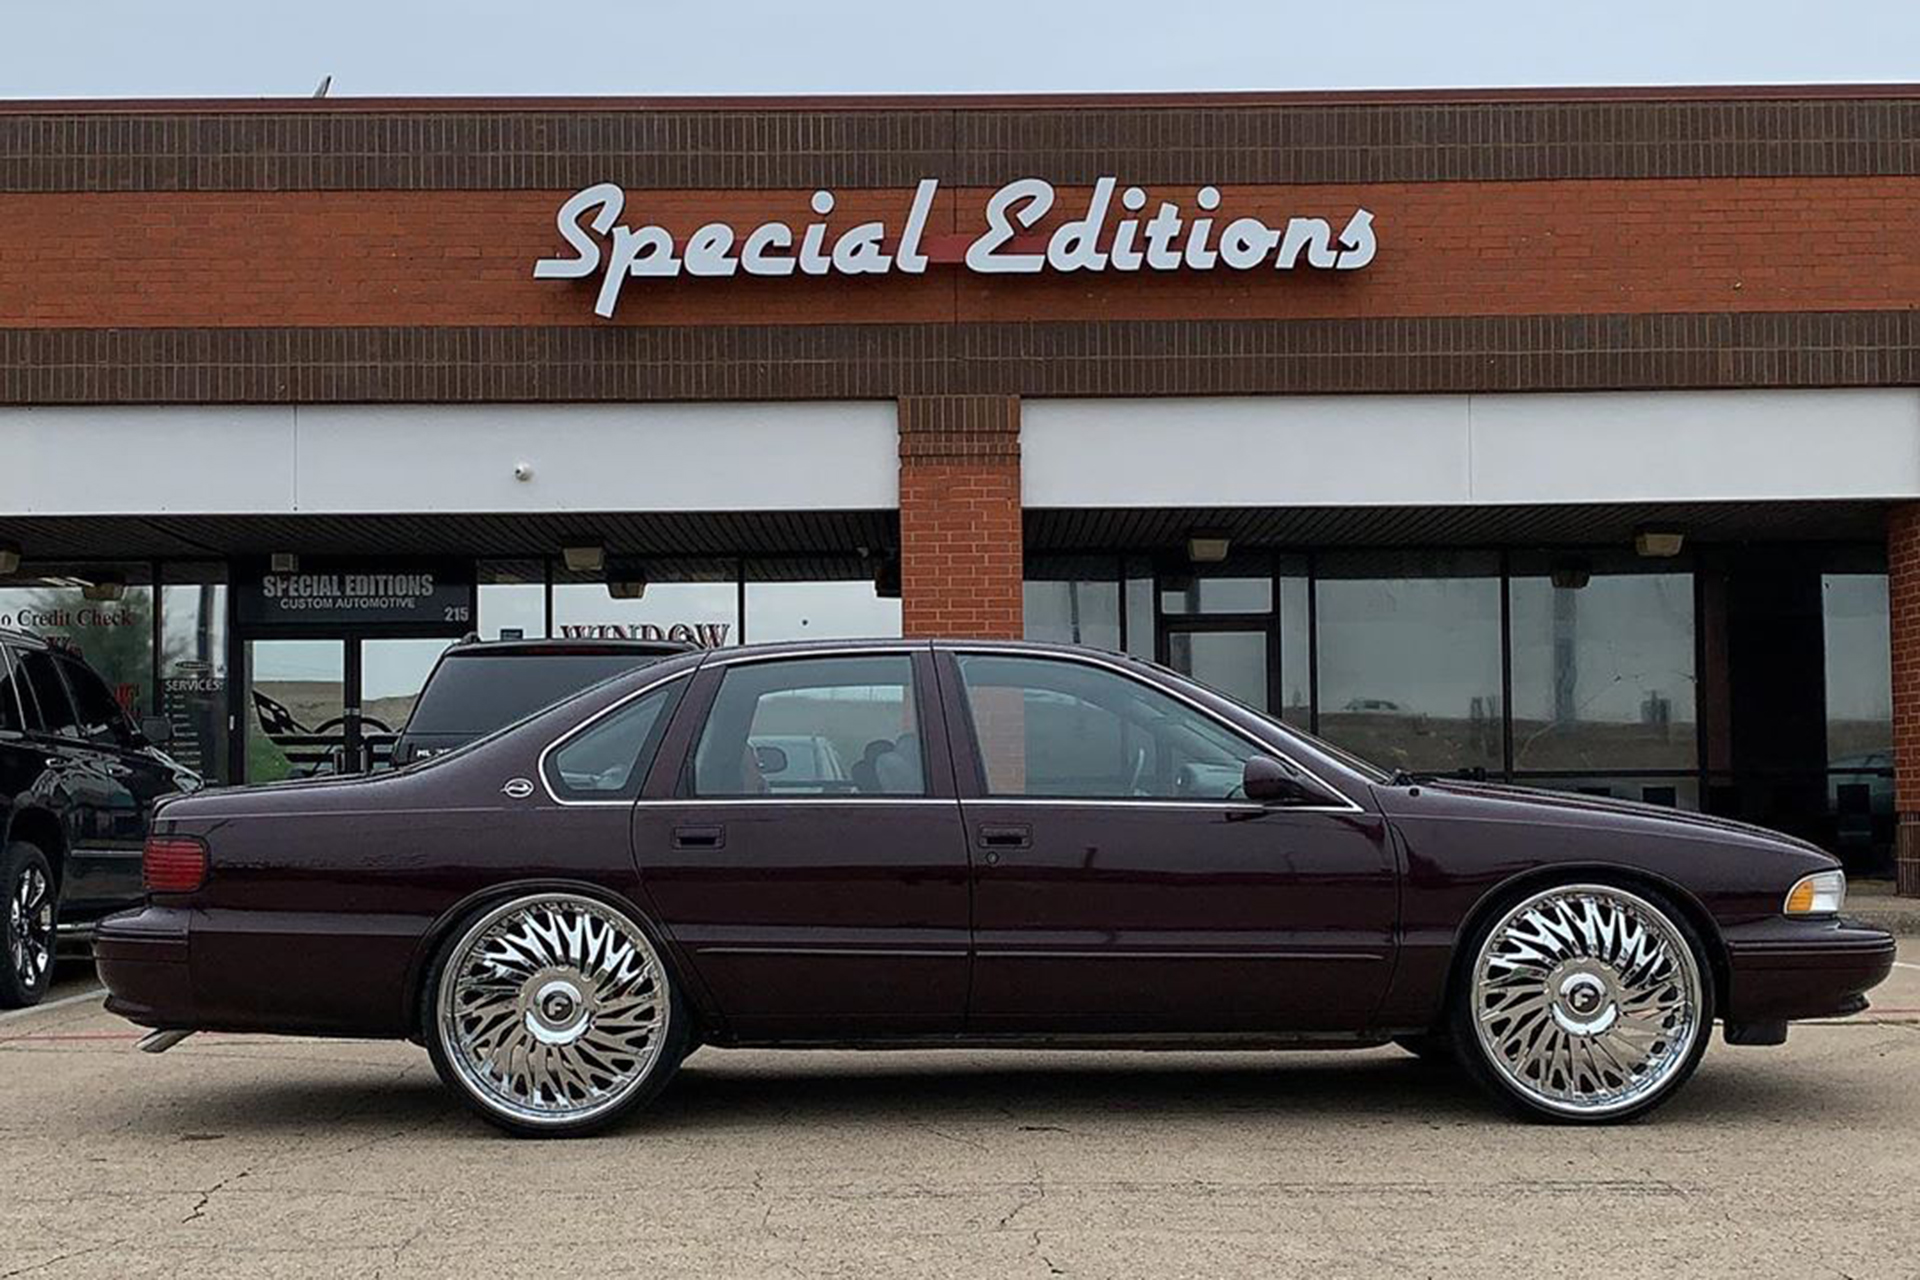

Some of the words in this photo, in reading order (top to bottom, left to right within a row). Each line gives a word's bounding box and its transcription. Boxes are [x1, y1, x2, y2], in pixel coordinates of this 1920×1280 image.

[534, 178, 940, 318] Special
[964, 176, 1379, 275] Editions
[262, 575, 341, 597] SPECIAL
[344, 574, 434, 596] EDITIONS
[280, 598, 333, 609] CUSTOM
[335, 597, 416, 609] AUTOMOTIVE
[17, 608, 71, 627] Credit
[77, 607, 133, 627] Check
[444, 606, 470, 622] 215
[559, 623, 731, 650] WINDOW
